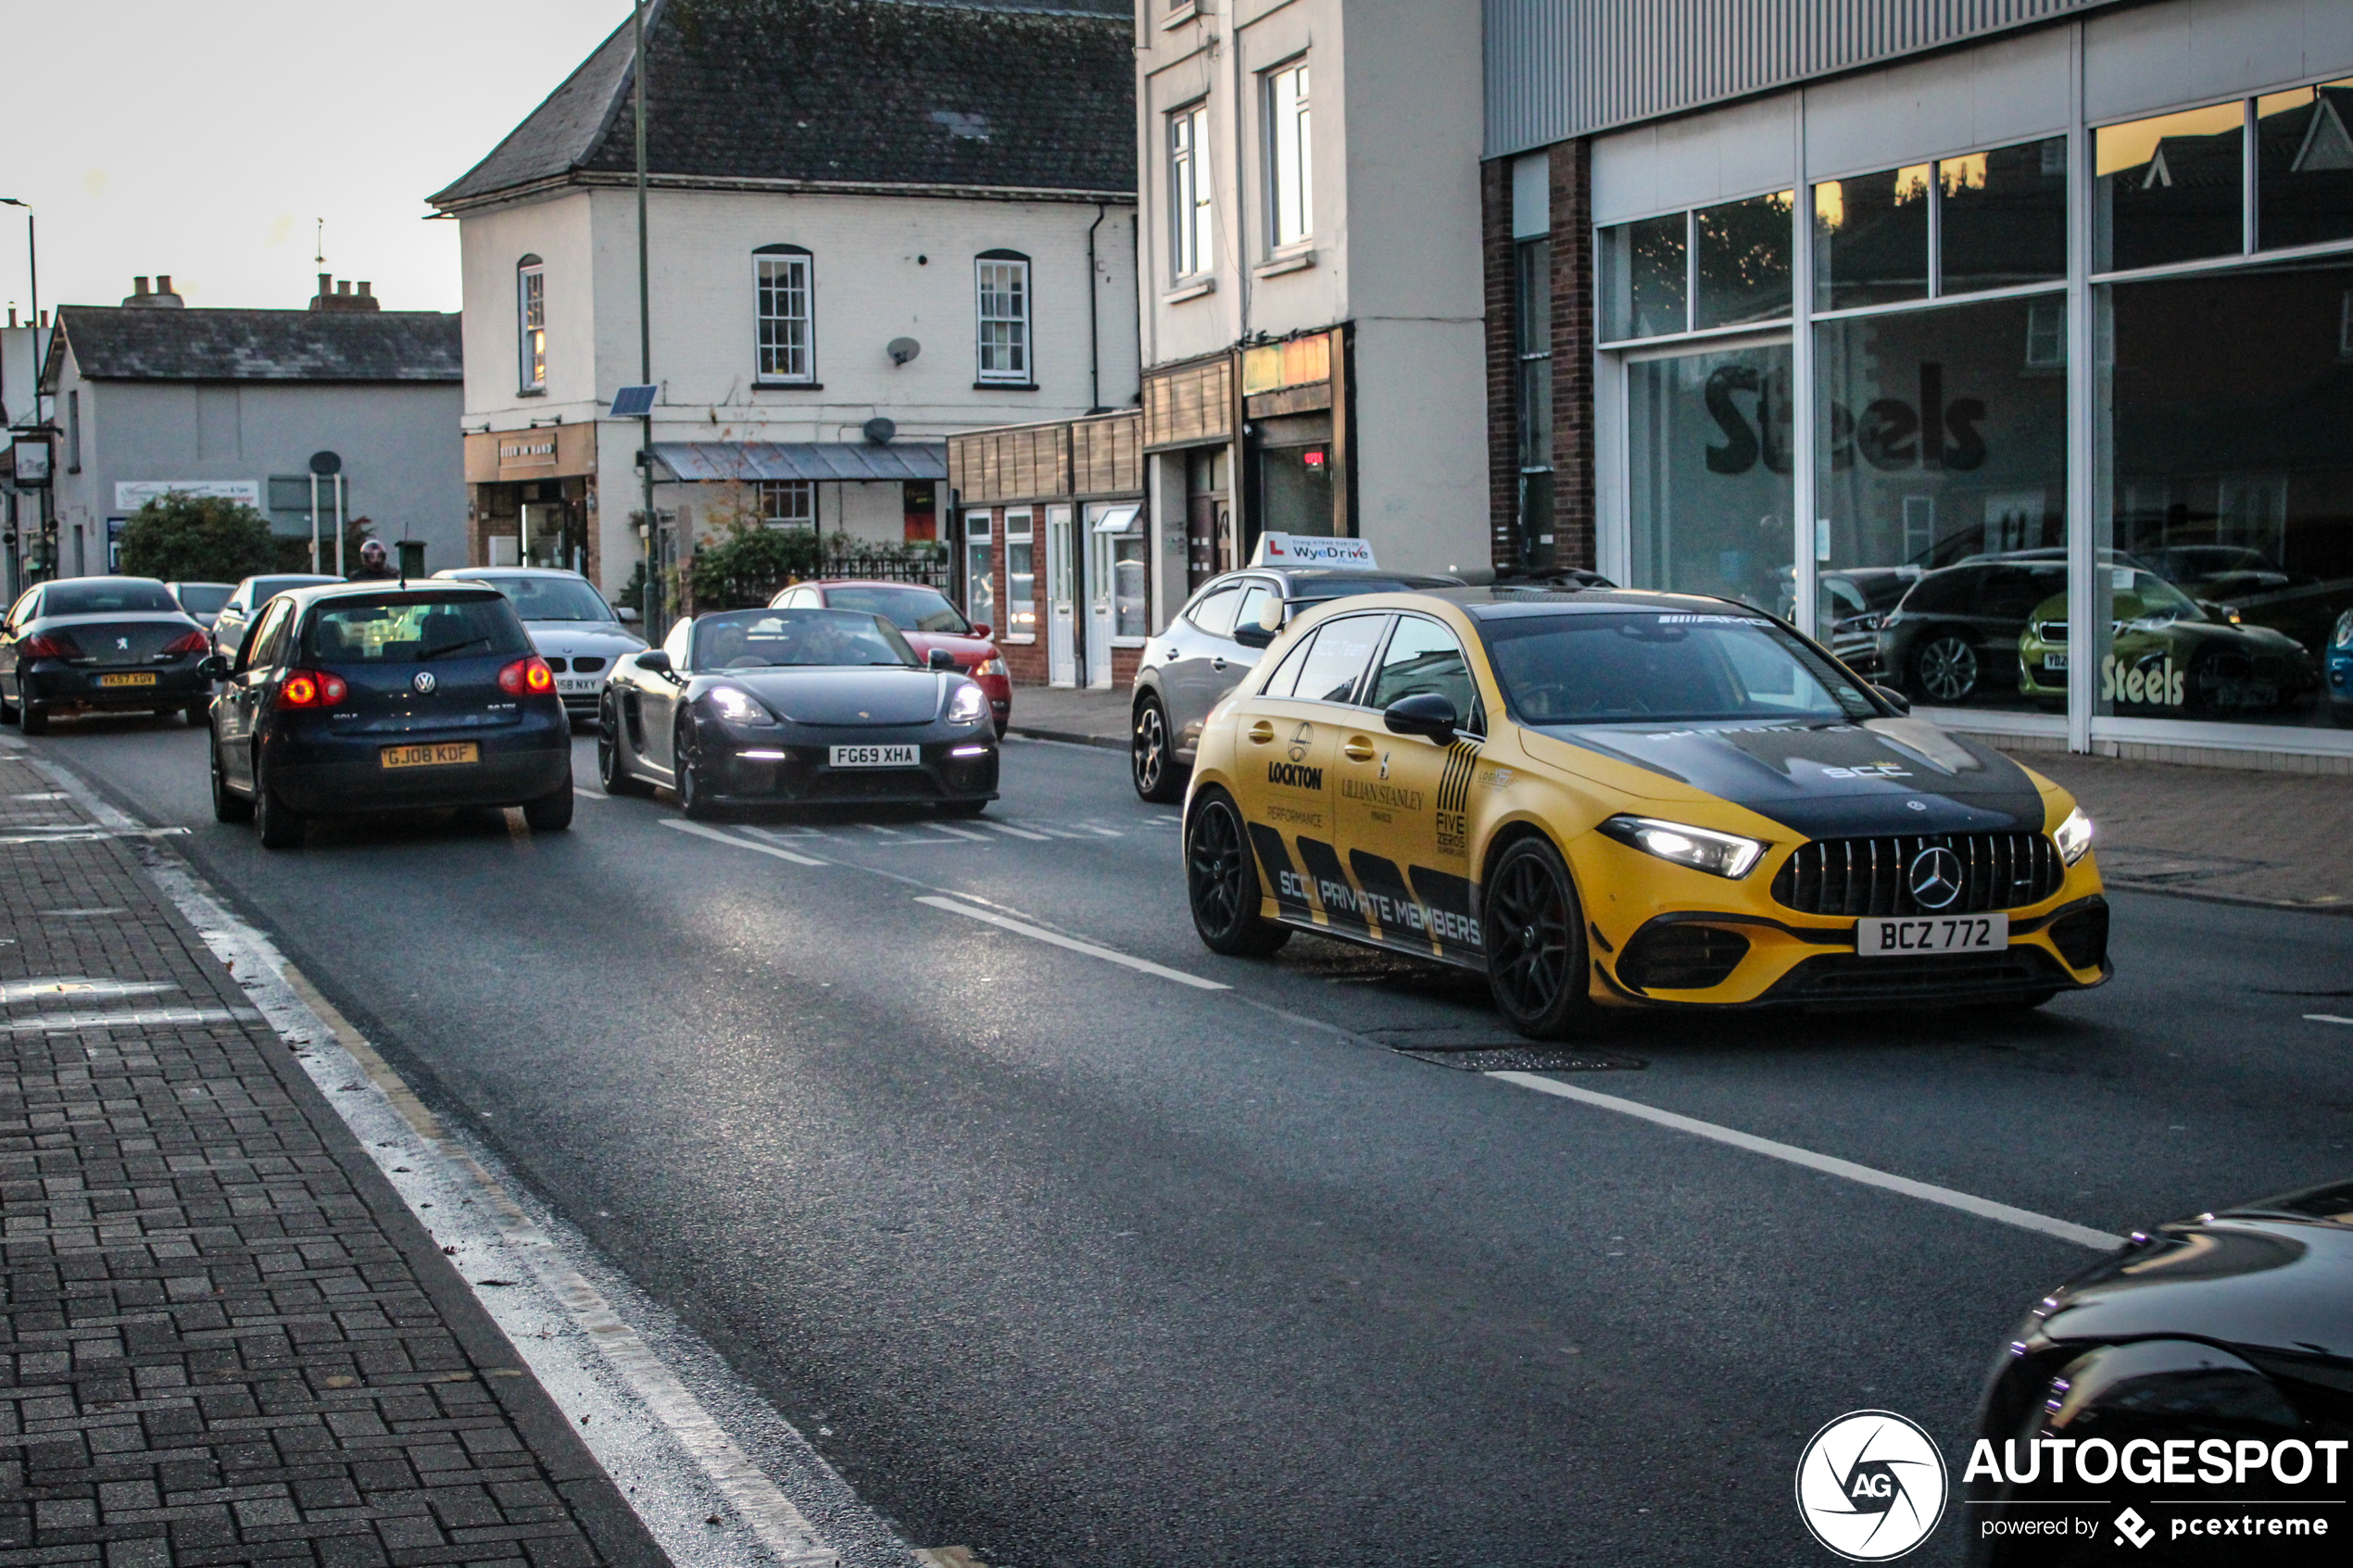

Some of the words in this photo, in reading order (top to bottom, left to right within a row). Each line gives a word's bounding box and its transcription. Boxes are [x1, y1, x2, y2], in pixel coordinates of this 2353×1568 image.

[1304, 452, 1324, 464] OPEN
[1269, 540, 1285, 555] L
[1294, 546, 1369, 560] WyeDrive
[103, 674, 130, 684] YK57
[576, 680, 597, 690] NXY
[2101, 653, 2184, 707] Steels
[388, 747, 433, 766] GJ08
[436, 746, 468, 763] KDF
[837, 747, 879, 763] FG69
[884, 747, 912, 762] XHA
[1268, 761, 1323, 790] LOCKTON
[1821, 765, 1914, 778] SCC
[1341, 778, 1378, 801] LILLIAN
[1379, 785, 1425, 810] STANLEY
[1267, 806, 1322, 828] PERFORMANCE
[1436, 812, 1465, 834] FIVE
[1437, 832, 1466, 848] ZEROS
[1279, 870, 1312, 900] SCC
[1321, 880, 1393, 922] PRIVATE
[1394, 898, 1482, 946] MEMBERS
[1881, 922, 1932, 949] BCZ
[1942, 919, 1991, 947] 772
